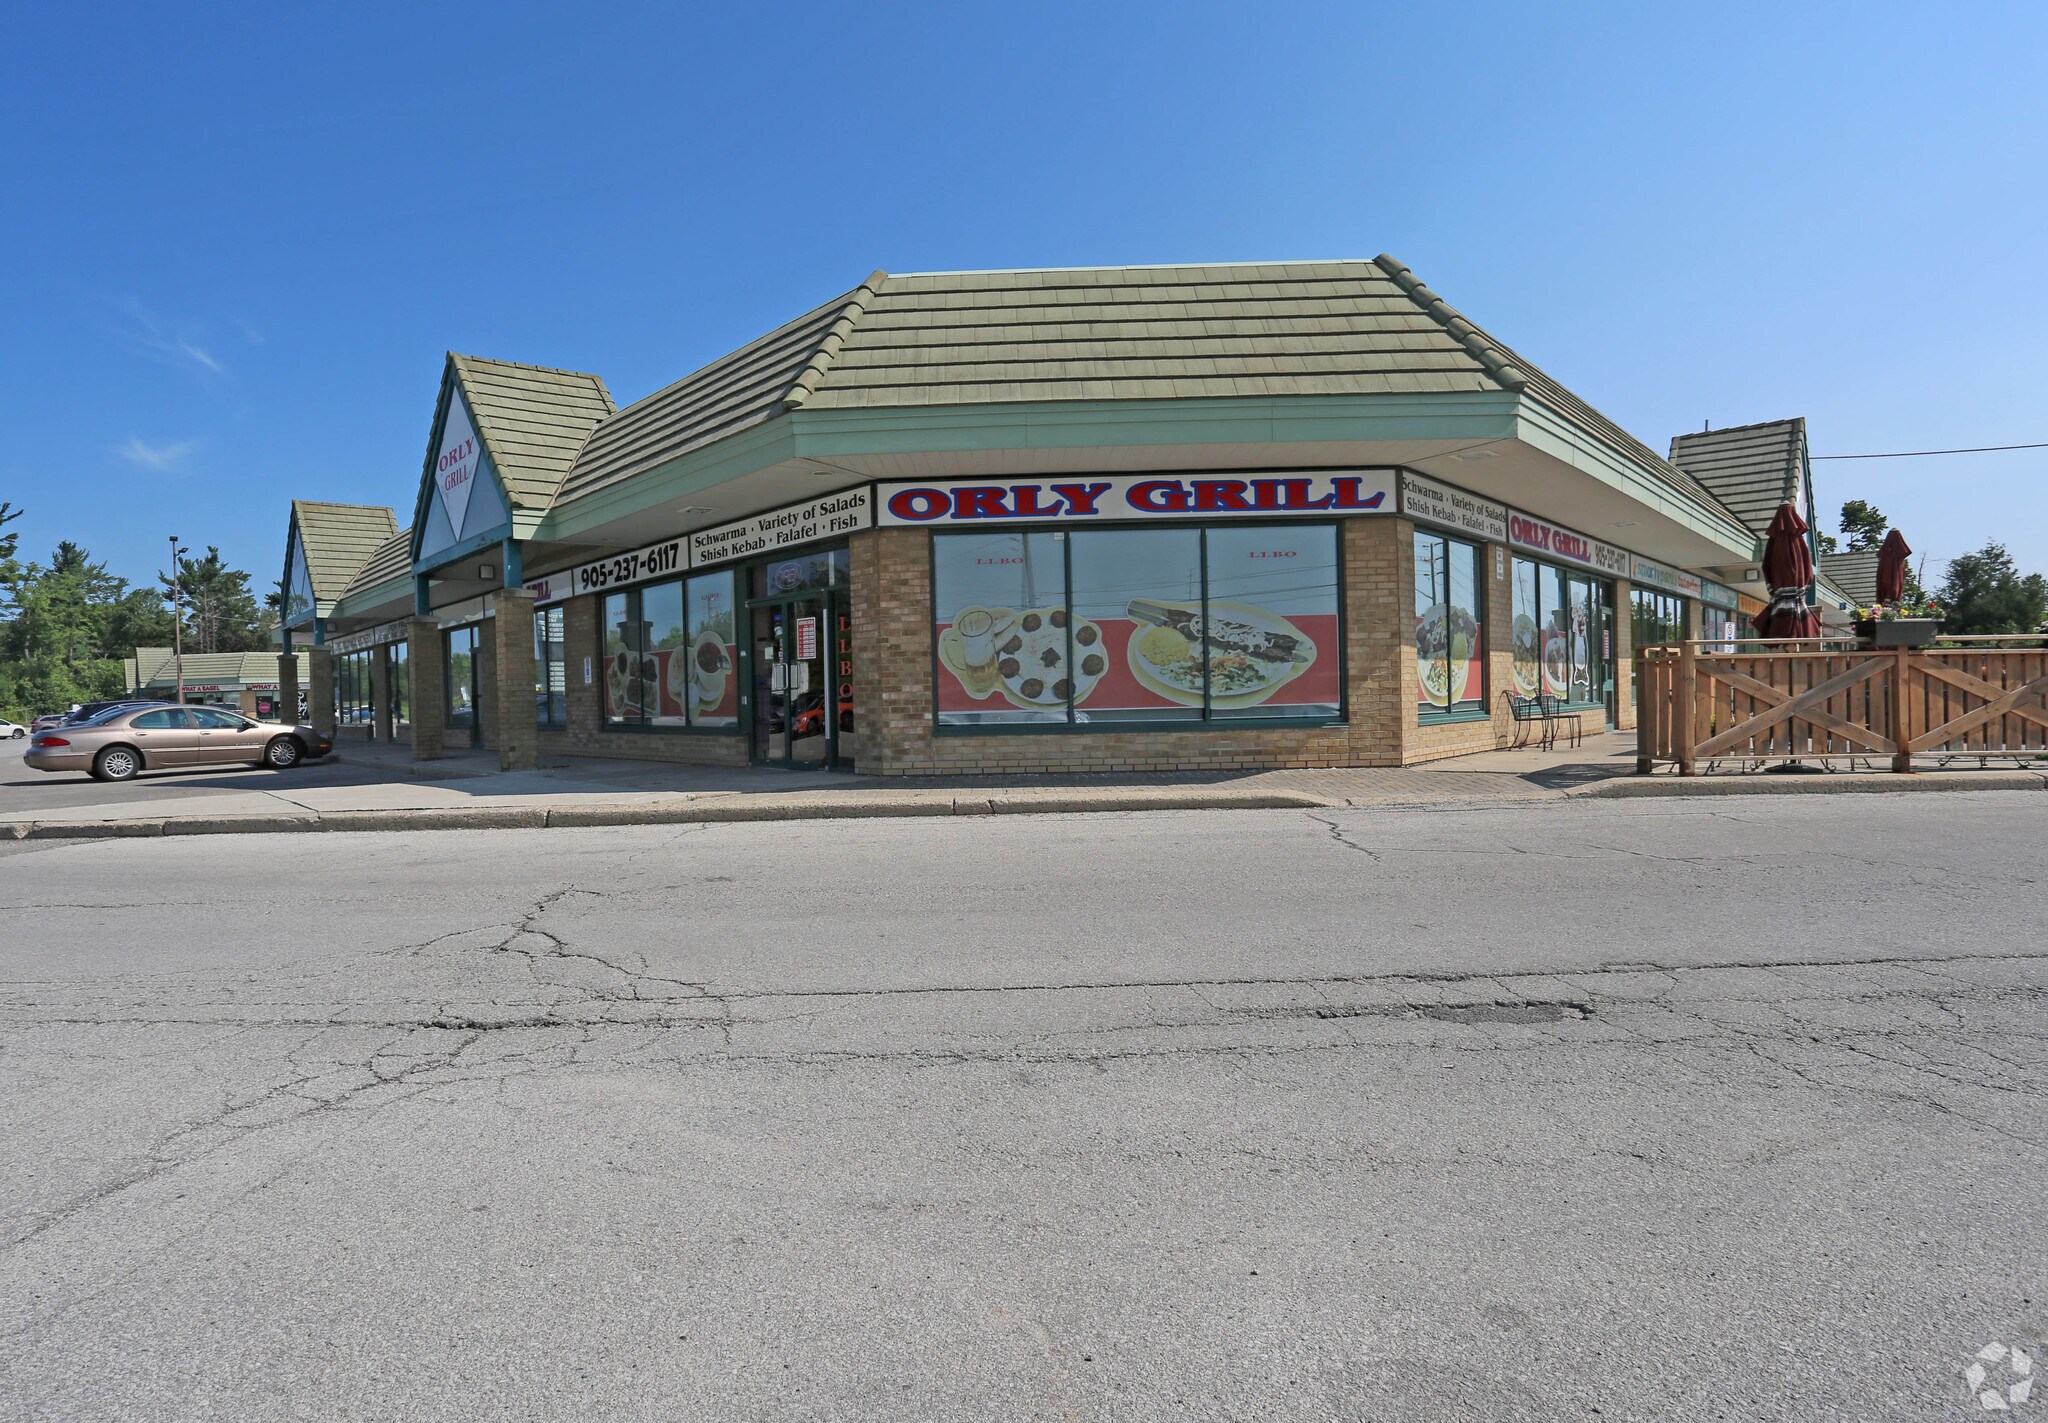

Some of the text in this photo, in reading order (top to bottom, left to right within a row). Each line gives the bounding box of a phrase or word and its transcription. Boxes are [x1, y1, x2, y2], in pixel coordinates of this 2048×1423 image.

[439, 436, 475, 472] ORLY
[445, 464, 469, 491] GRILL
[888, 476, 1386, 521] ORLY GRILL
[1402, 476, 1507, 523] Schwarma Variety of Salads
[694, 493, 866, 549] Schwarma Variety of Salads
[700, 514, 858, 562] Shish Kebab Falafel Fish
[1407, 496, 1503, 537] Shish Kebab Falafel Fish
[1510, 515, 1551, 550] ORLY
[1552, 530, 1591, 563] GRILL
[581, 542, 679, 591] 905-237-6117
[976, 557, 1024, 565] LLBO
[526, 580, 551, 602] ILL
[839, 616, 854, 698] LLBO
